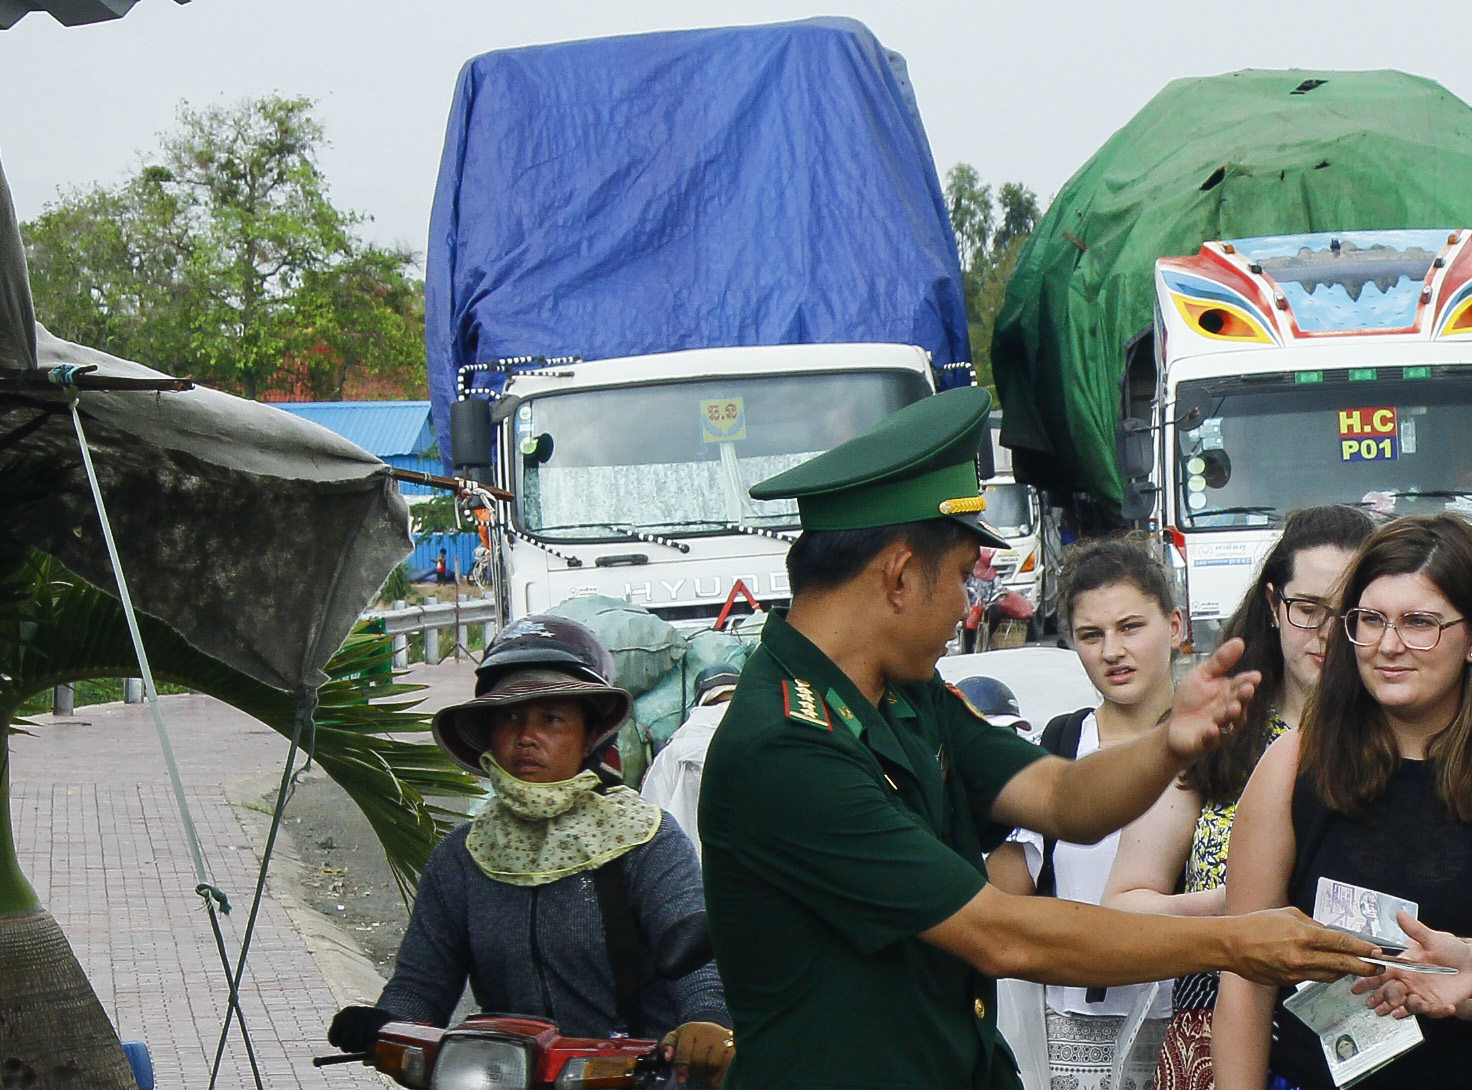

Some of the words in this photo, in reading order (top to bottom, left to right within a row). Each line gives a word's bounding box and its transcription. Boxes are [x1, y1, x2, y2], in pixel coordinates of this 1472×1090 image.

[1339, 409, 1395, 434] H.C
[1342, 438, 1392, 461] P01
[624, 572, 791, 602] HYUND
